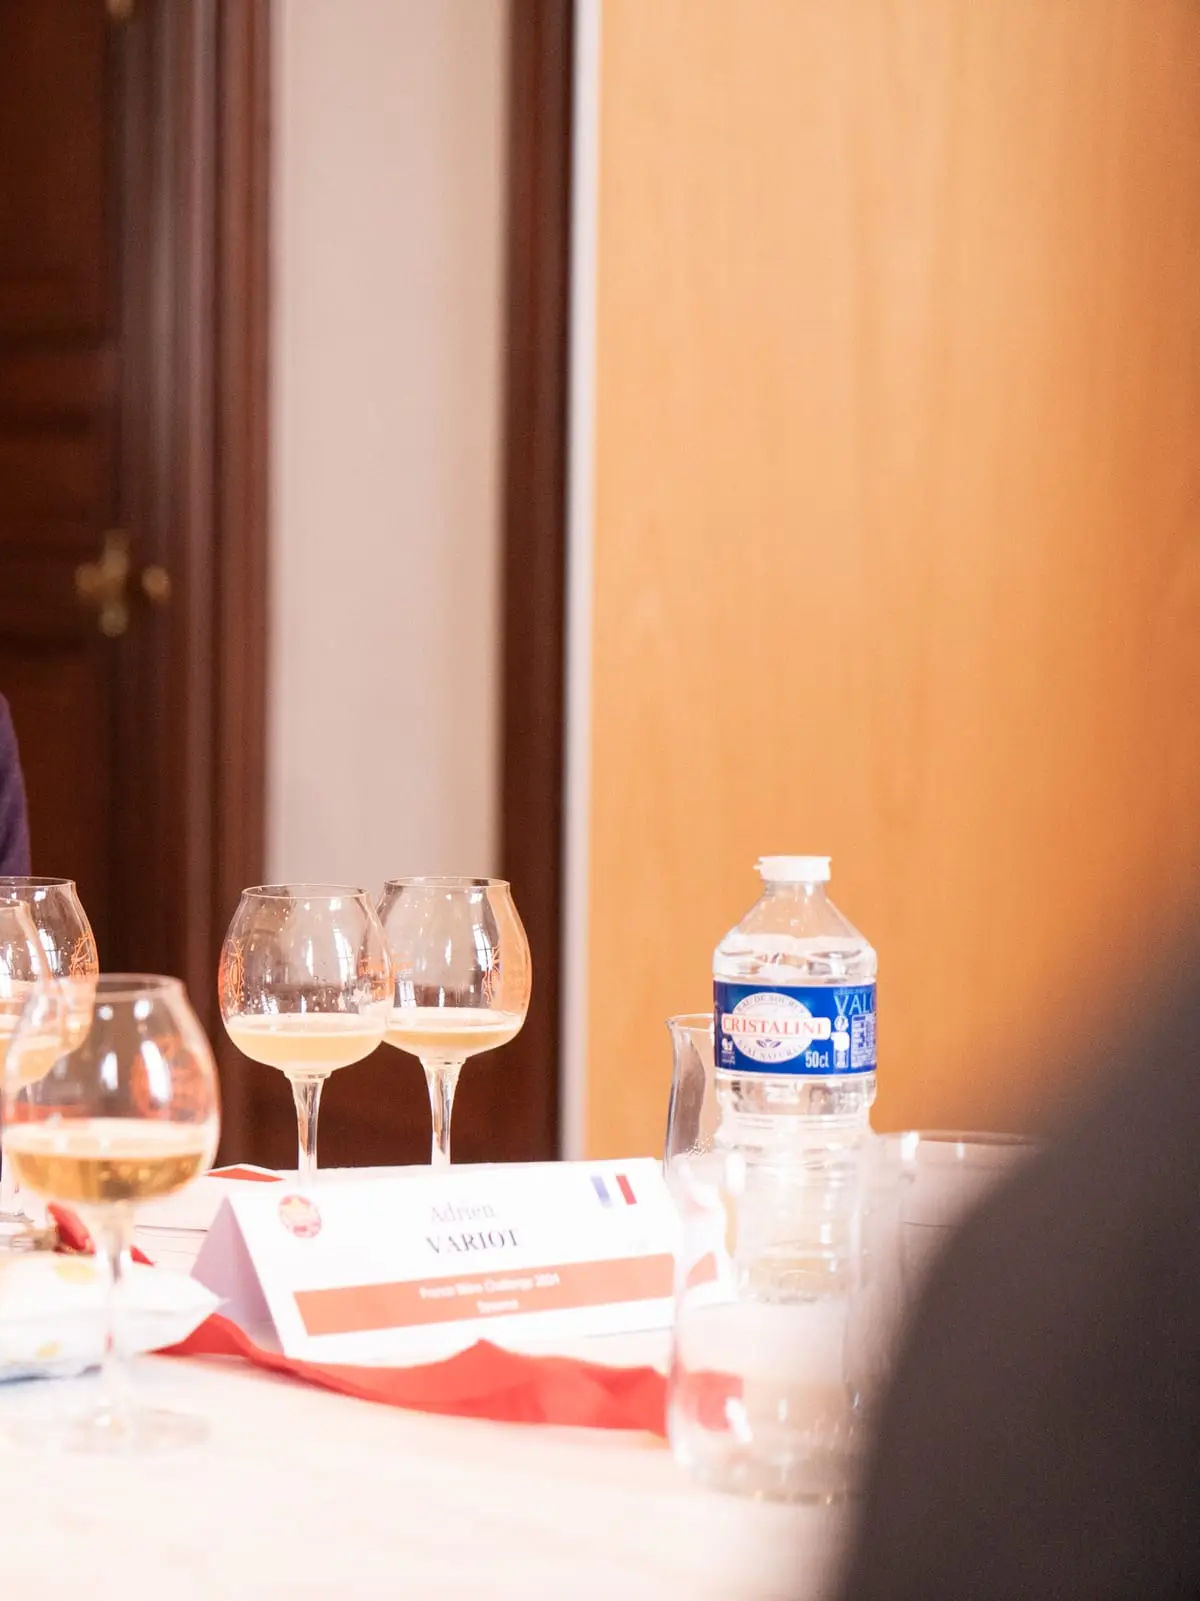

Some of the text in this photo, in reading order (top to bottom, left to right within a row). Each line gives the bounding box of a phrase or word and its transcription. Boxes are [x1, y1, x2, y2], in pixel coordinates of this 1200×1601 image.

[805, 1050, 829, 1068] 50cl
[431, 1201, 496, 1222] Adrien
[425, 1228, 520, 1254] VARIOT
